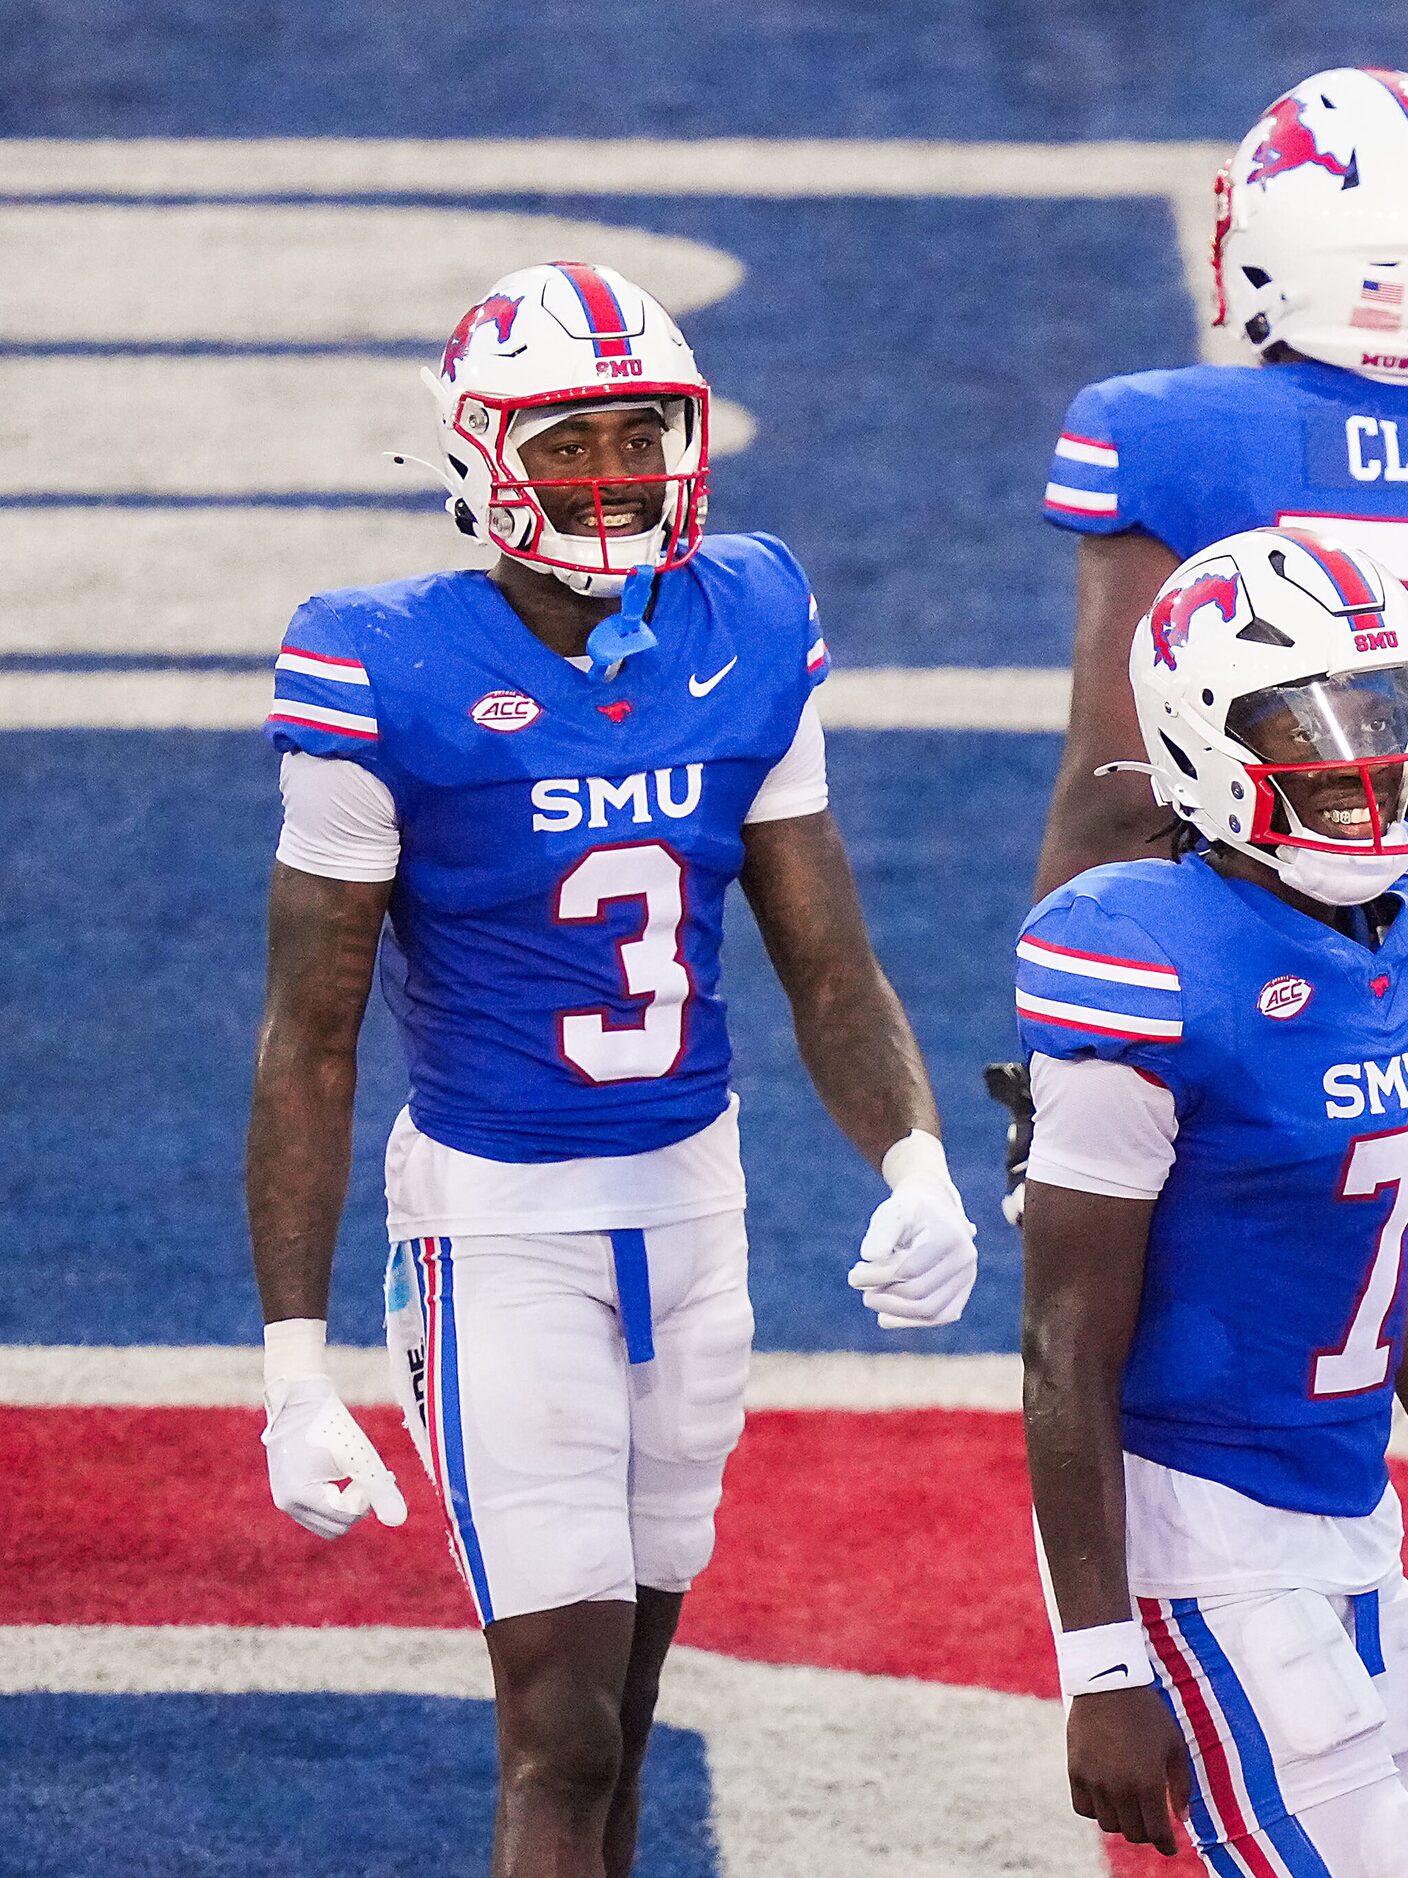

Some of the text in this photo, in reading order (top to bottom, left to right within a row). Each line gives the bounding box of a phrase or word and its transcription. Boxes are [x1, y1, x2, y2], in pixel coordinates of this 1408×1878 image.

[1354, 630, 1399, 652] SMU
[481, 701, 530, 716] ACC
[530, 763, 704, 832] SMU
[553, 838, 693, 1087] 3
[1266, 982, 1303, 1009] ACC
